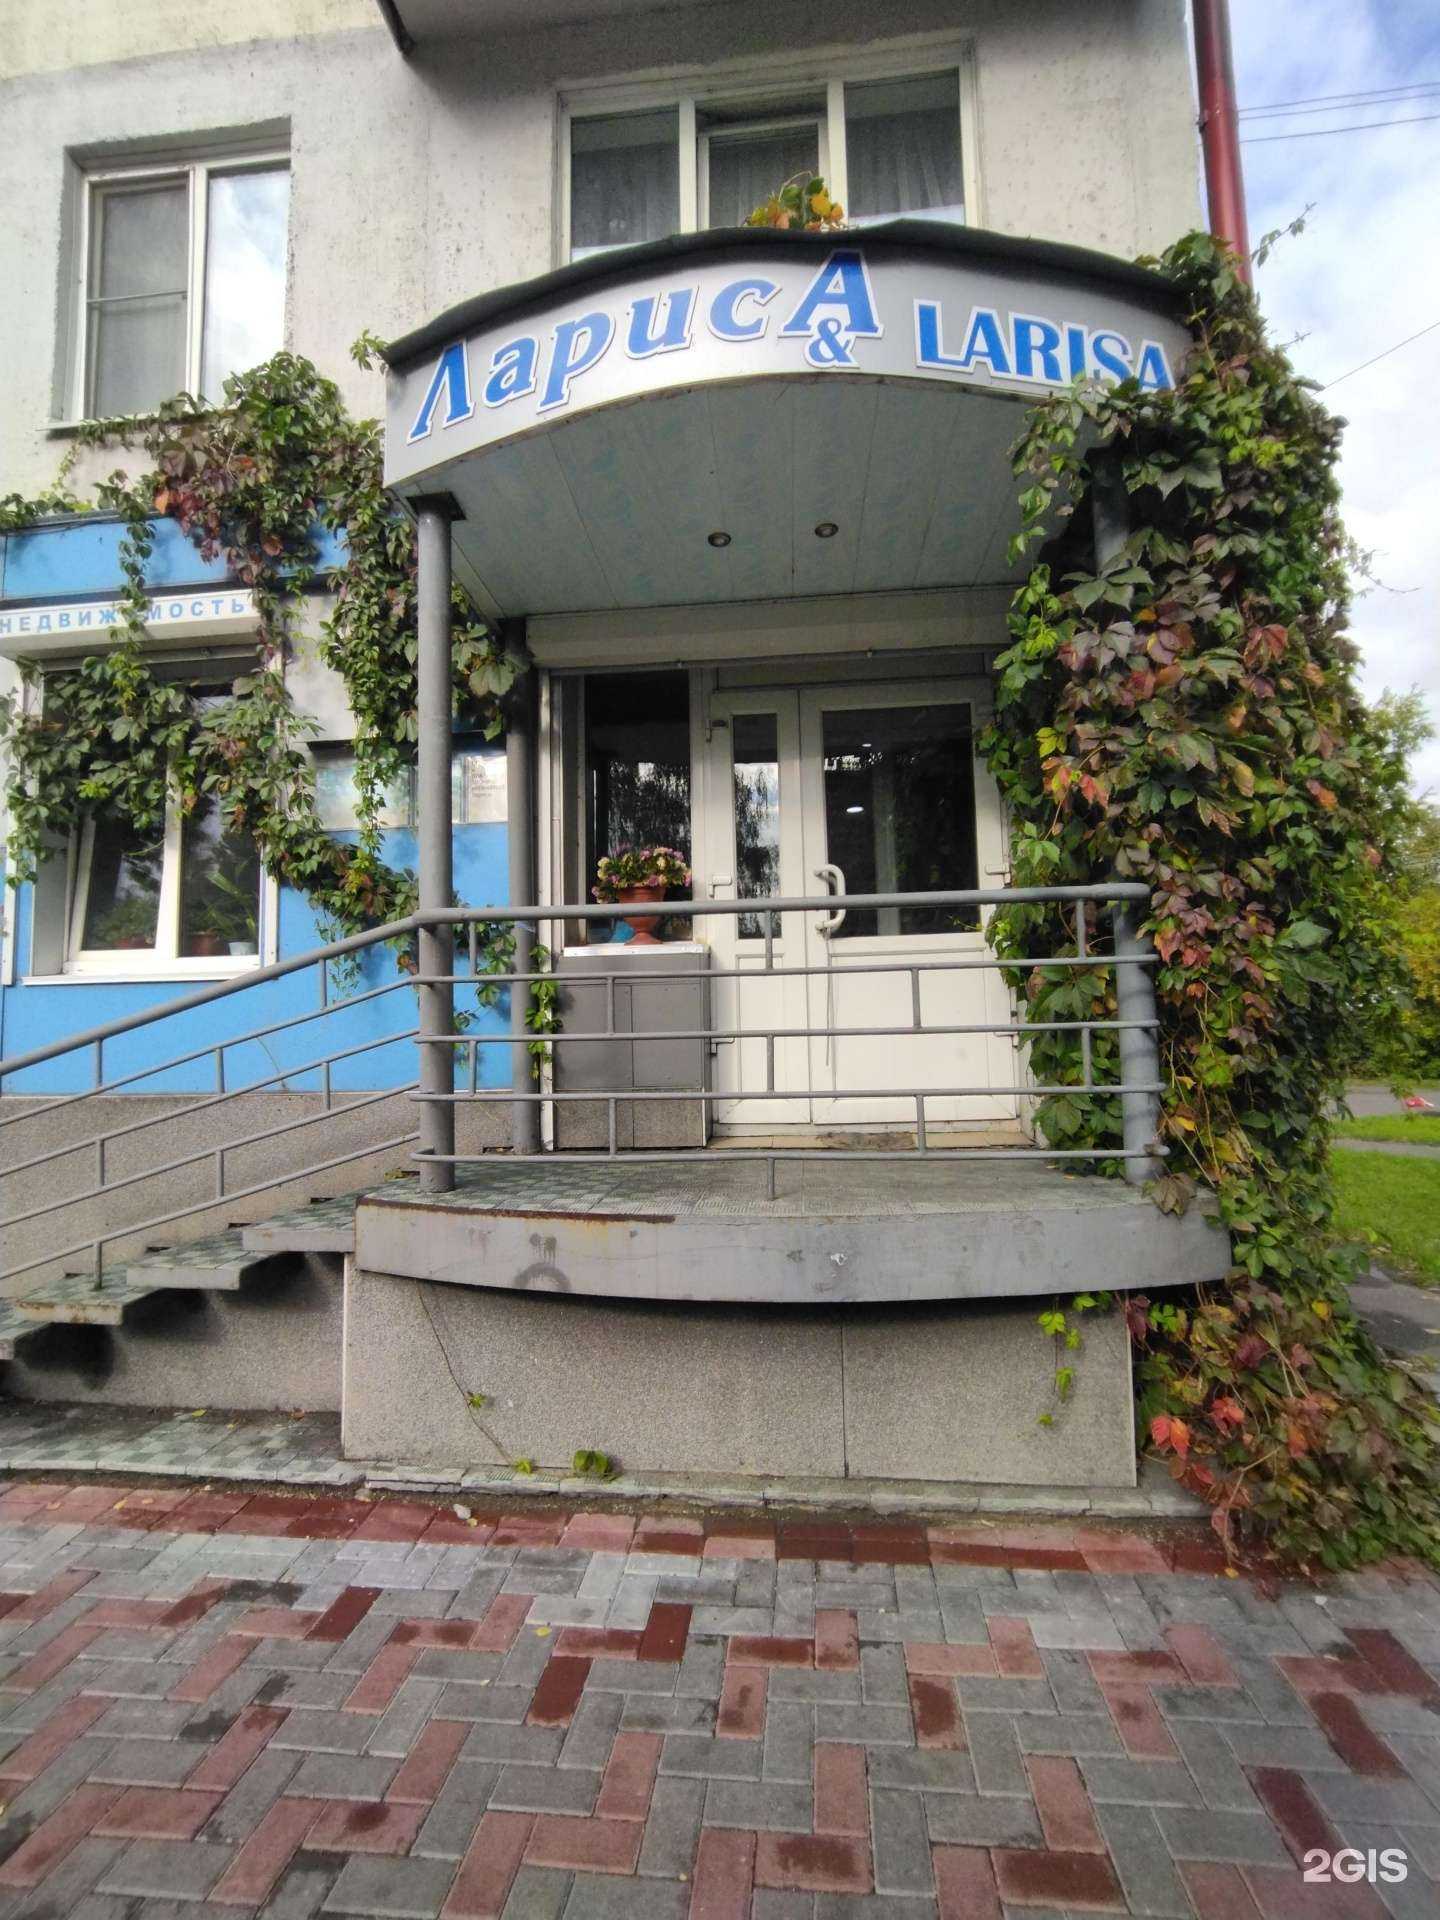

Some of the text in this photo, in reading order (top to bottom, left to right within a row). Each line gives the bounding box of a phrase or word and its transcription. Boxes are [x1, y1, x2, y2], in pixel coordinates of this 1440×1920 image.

[407, 249, 1174, 442] ЛарисА & LARISA
[0, 598, 245, 634] НЕДВИЖМОСТЬ
